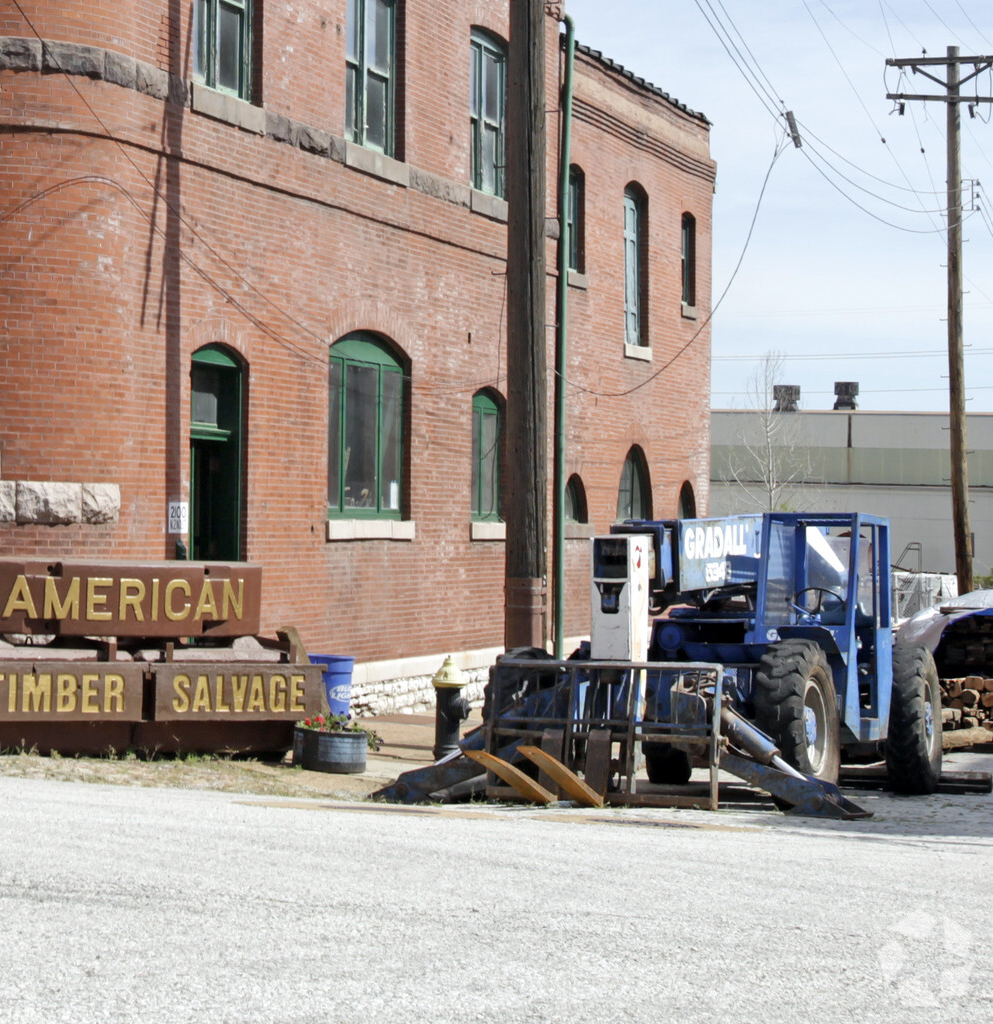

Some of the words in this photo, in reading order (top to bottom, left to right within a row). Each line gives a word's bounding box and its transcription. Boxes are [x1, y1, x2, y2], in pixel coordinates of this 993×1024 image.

[170, 505, 187, 519] 2100
[684, 524, 747, 560] GRADALL
[2, 574, 244, 621] AMERICAN
[172, 673, 306, 713] SALVAGE
